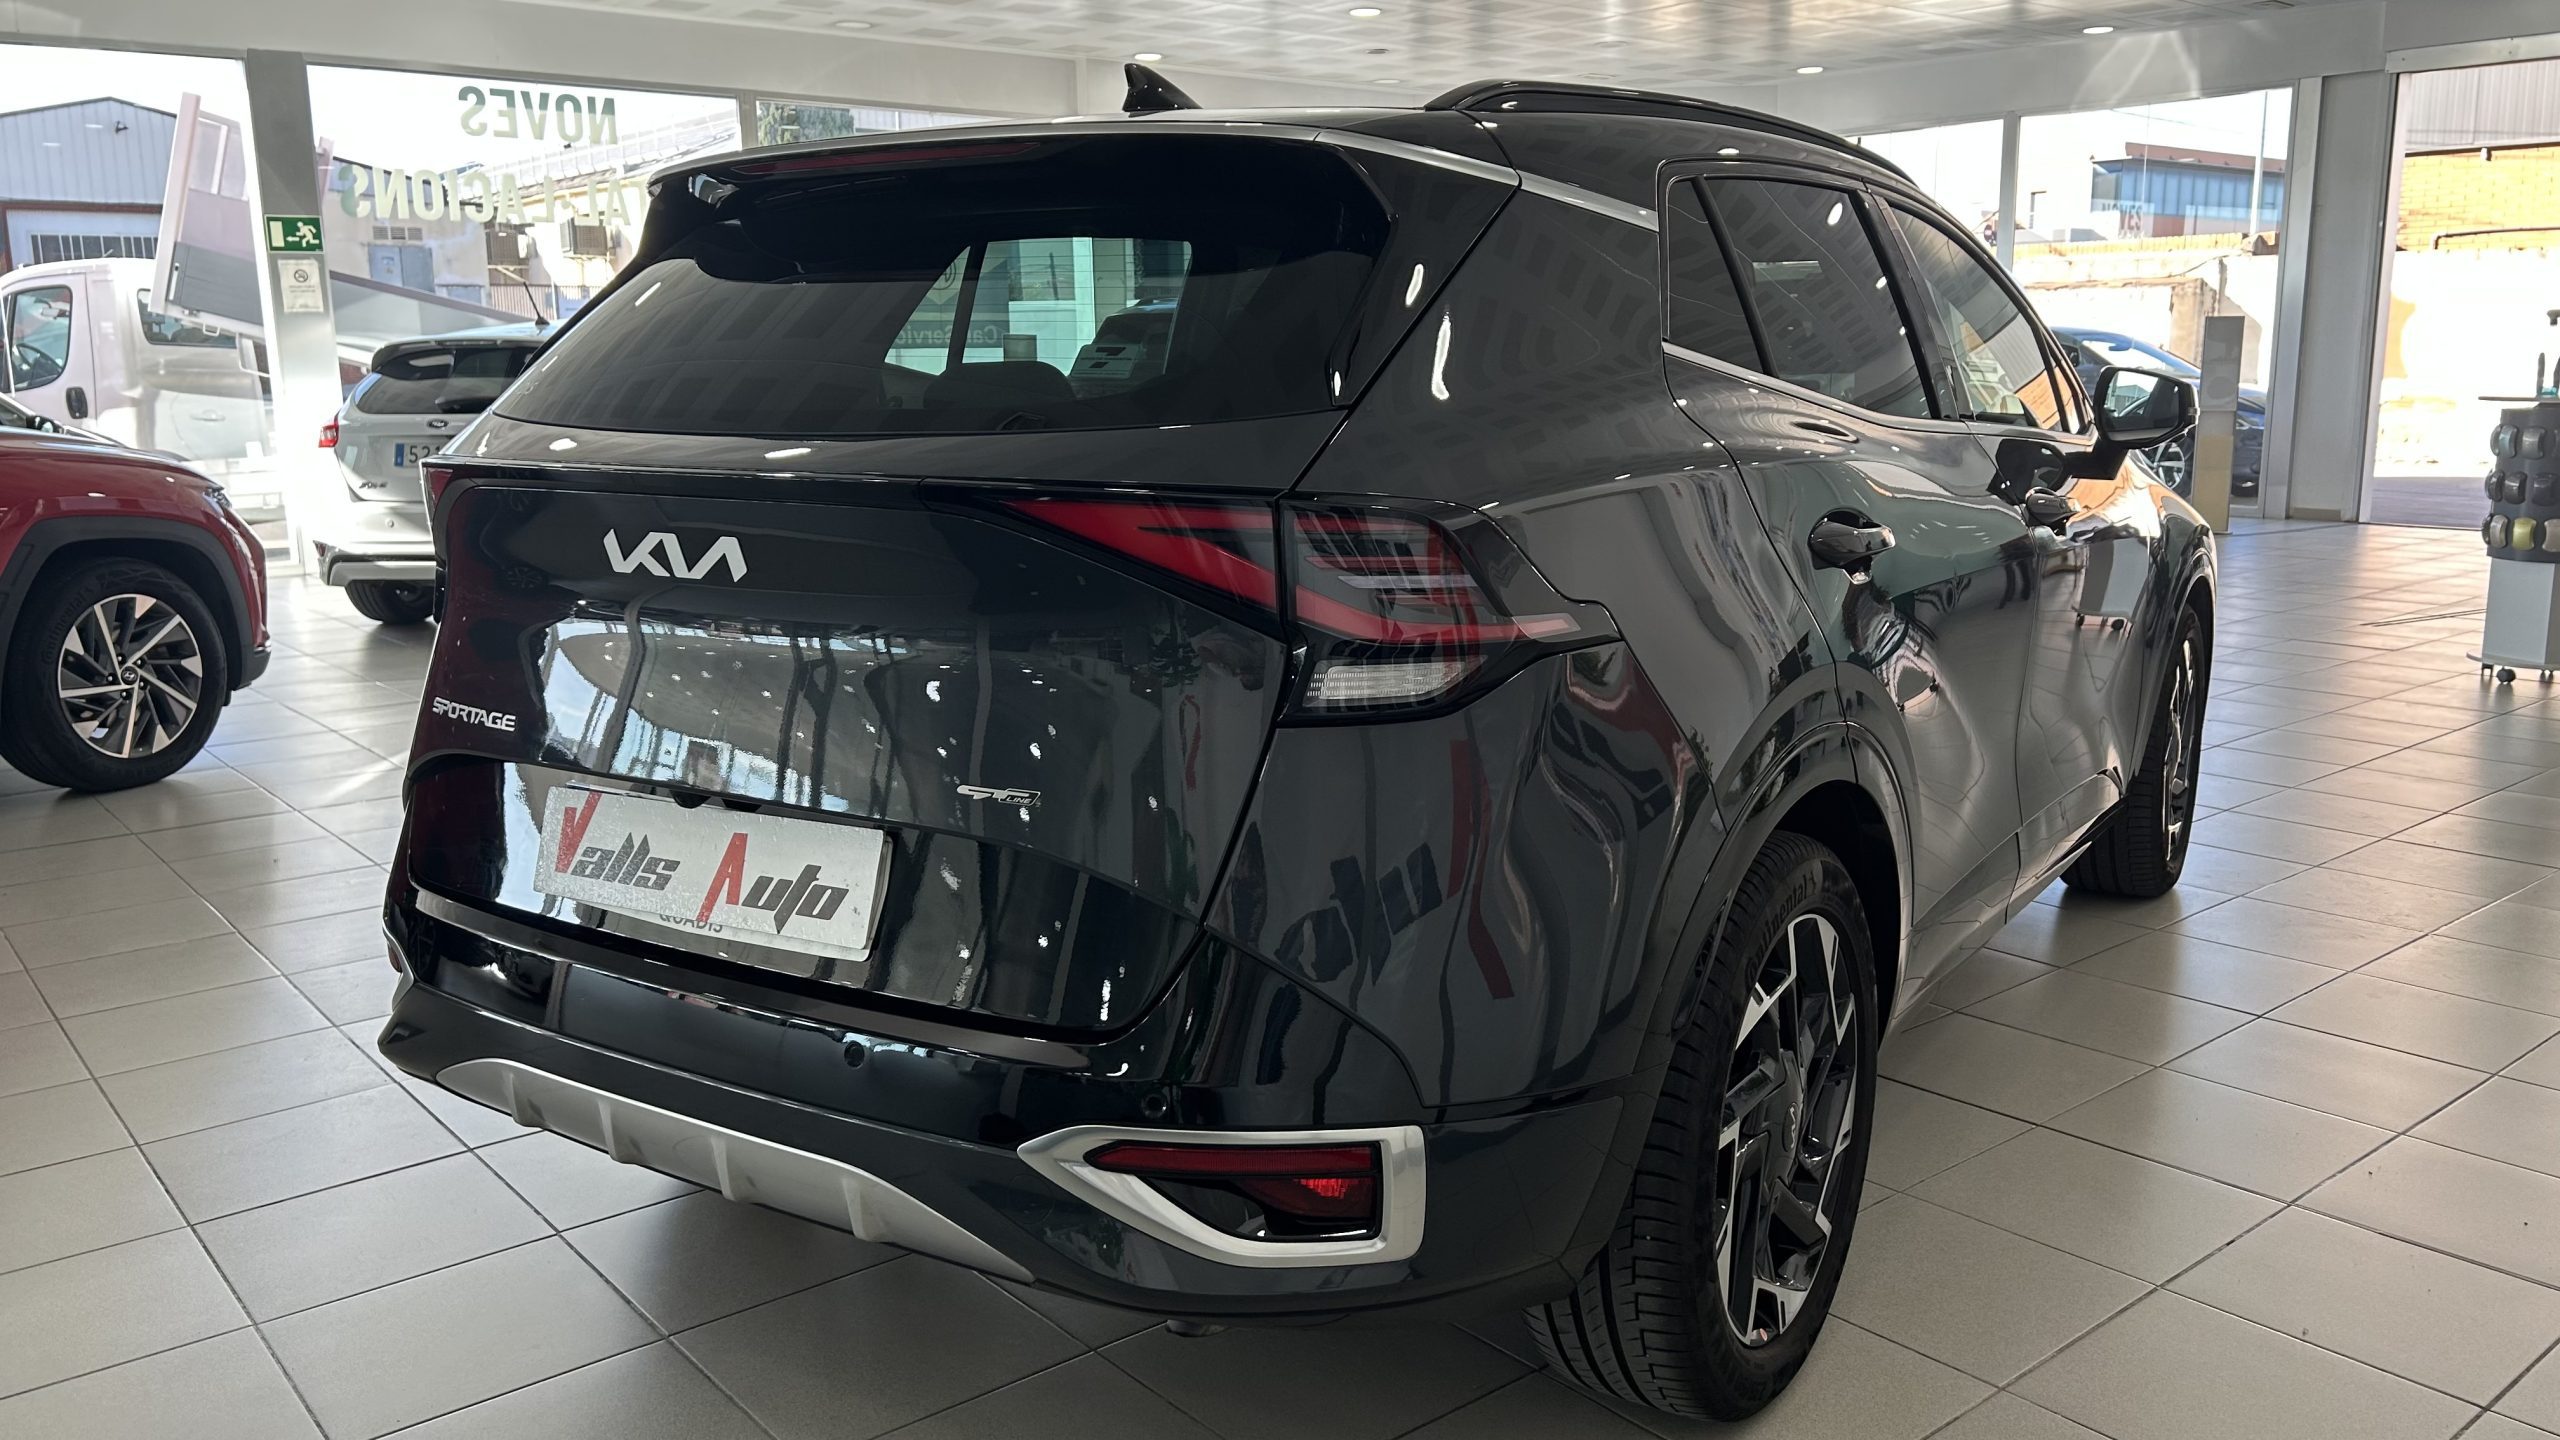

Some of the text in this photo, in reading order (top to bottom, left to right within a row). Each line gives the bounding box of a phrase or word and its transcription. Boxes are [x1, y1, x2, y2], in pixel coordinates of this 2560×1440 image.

[408, 445, 440, 464] 52
[603, 528, 748, 583] KIA
[432, 697, 516, 732] SPORTAGE
[1006, 796, 1032, 804] LINE
[554, 791, 850, 935] Valls Auto
